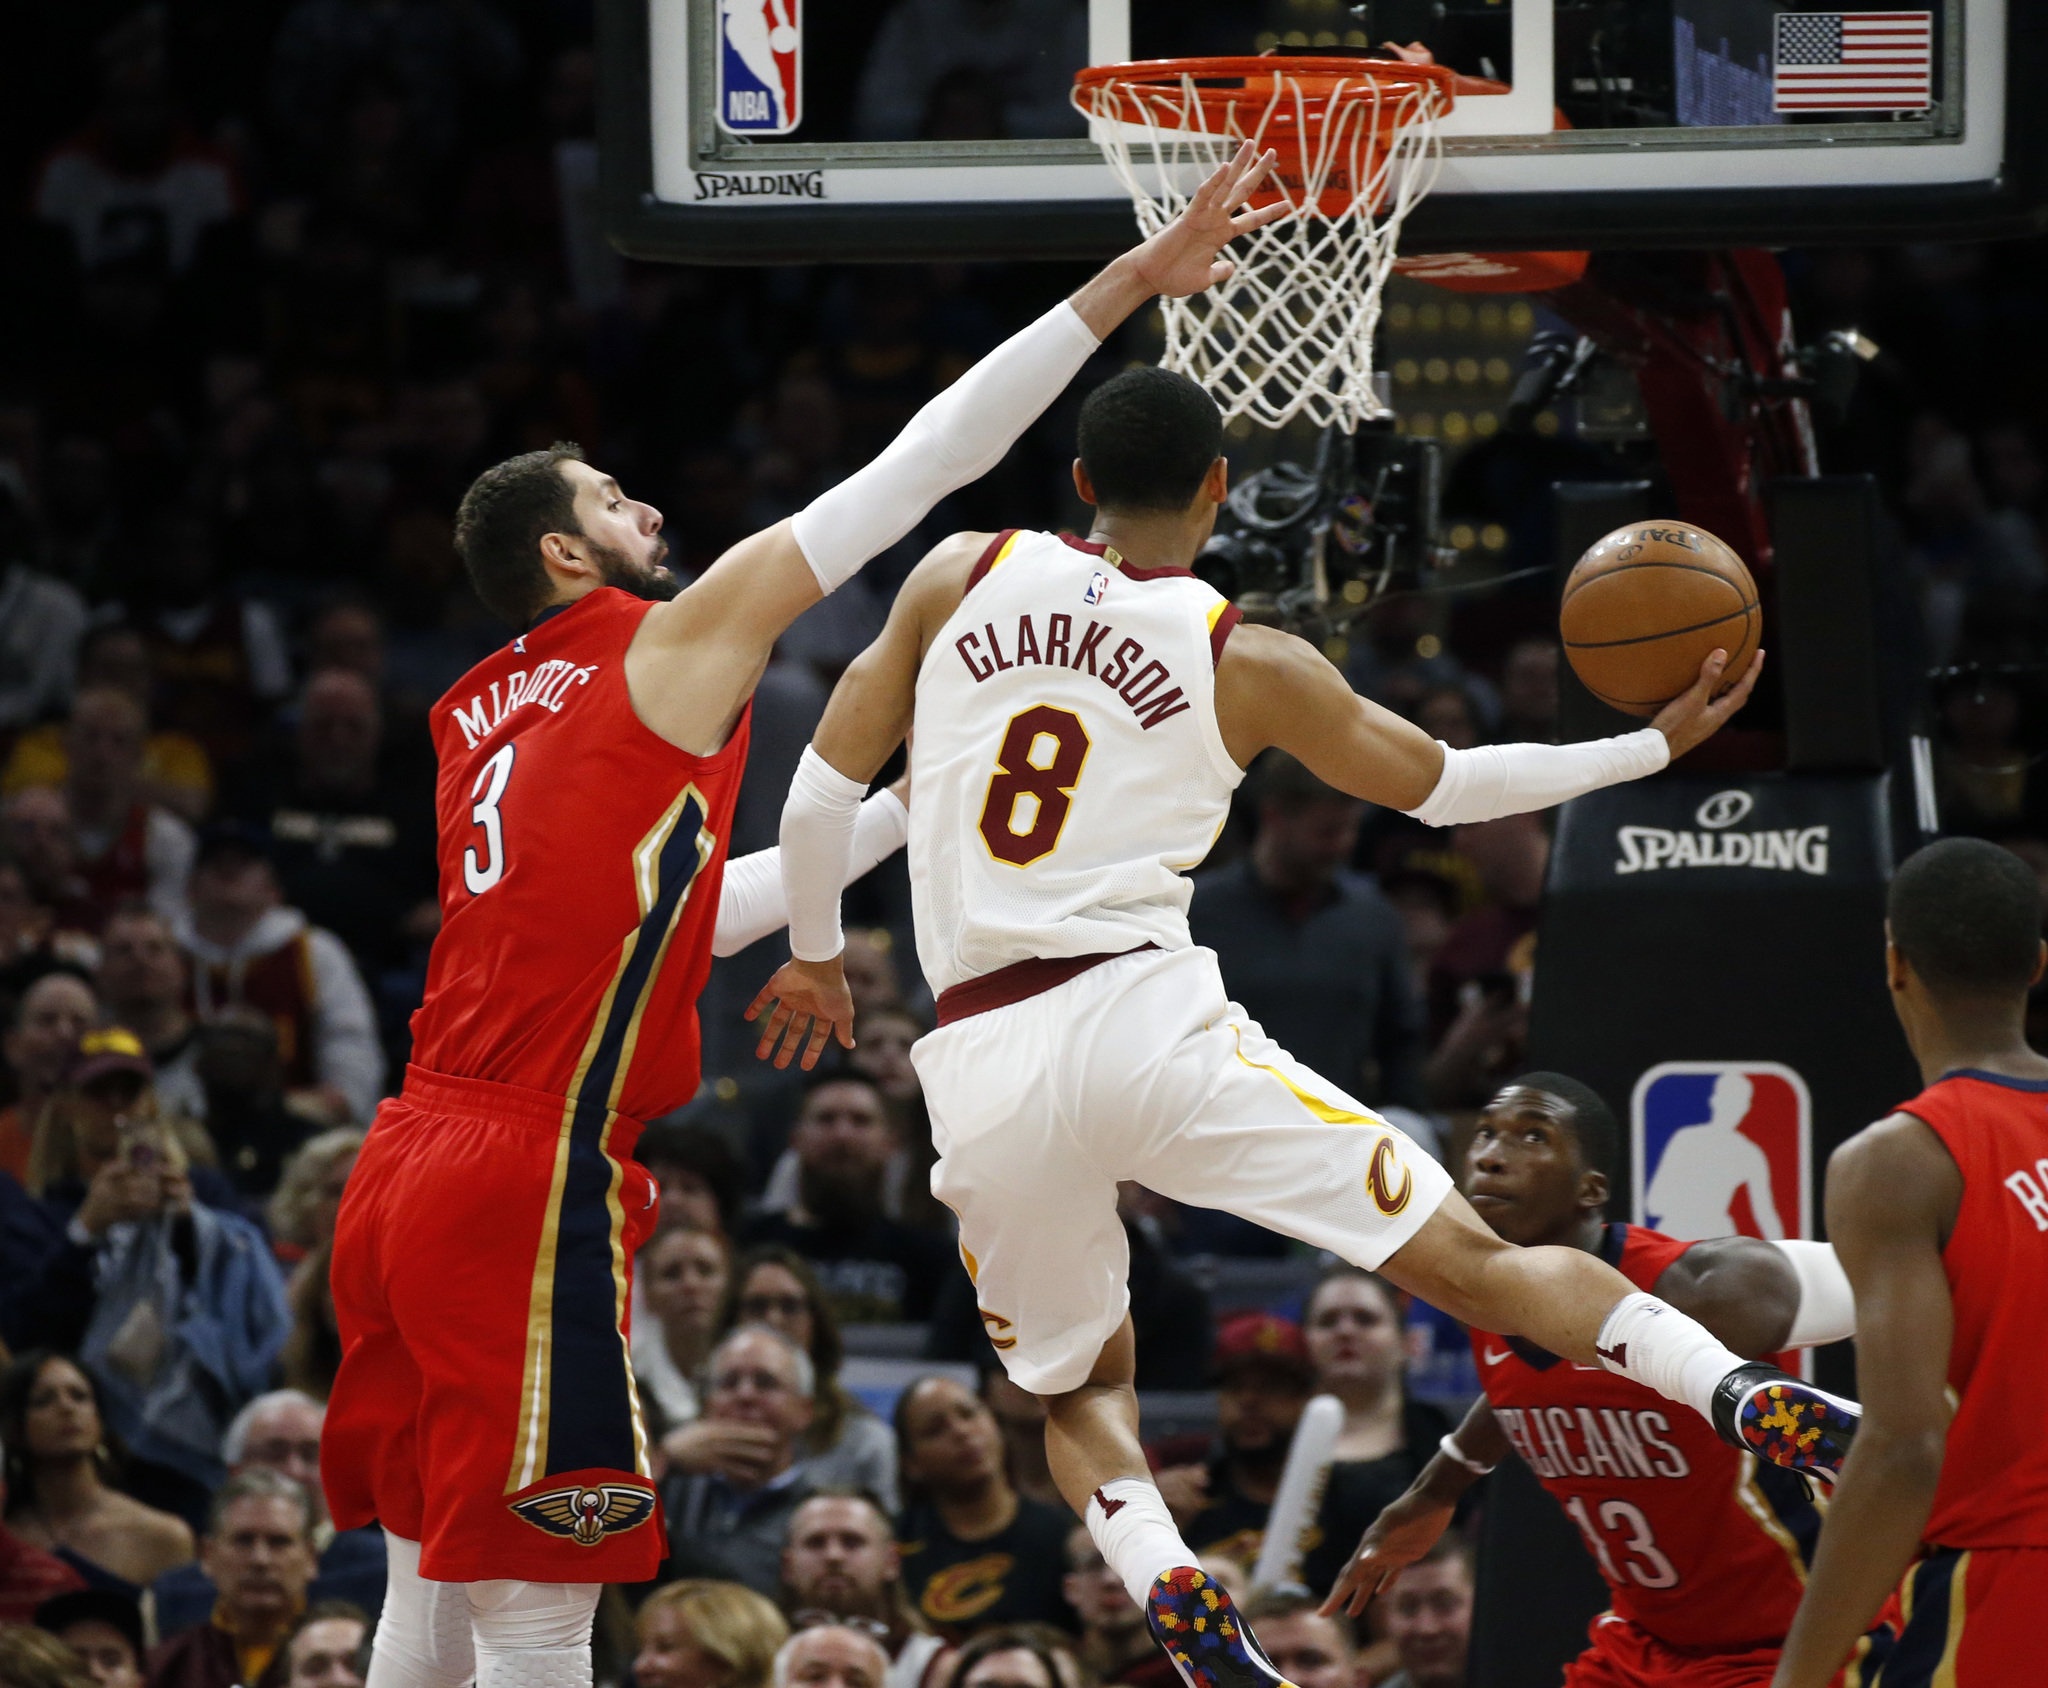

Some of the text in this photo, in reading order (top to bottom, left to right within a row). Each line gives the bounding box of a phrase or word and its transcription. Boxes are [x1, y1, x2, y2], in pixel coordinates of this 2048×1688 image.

[728, 90, 771, 121] NBA
[694, 169, 828, 201] SPALDING
[452, 659, 599, 750] MIROTIĆ
[956, 613, 1191, 731] CLARKSON
[463, 741, 516, 898] 3
[978, 703, 1093, 870] 8
[1614, 825, 1830, 876] SPALDING
[1565, 1496, 1680, 1589] 13
